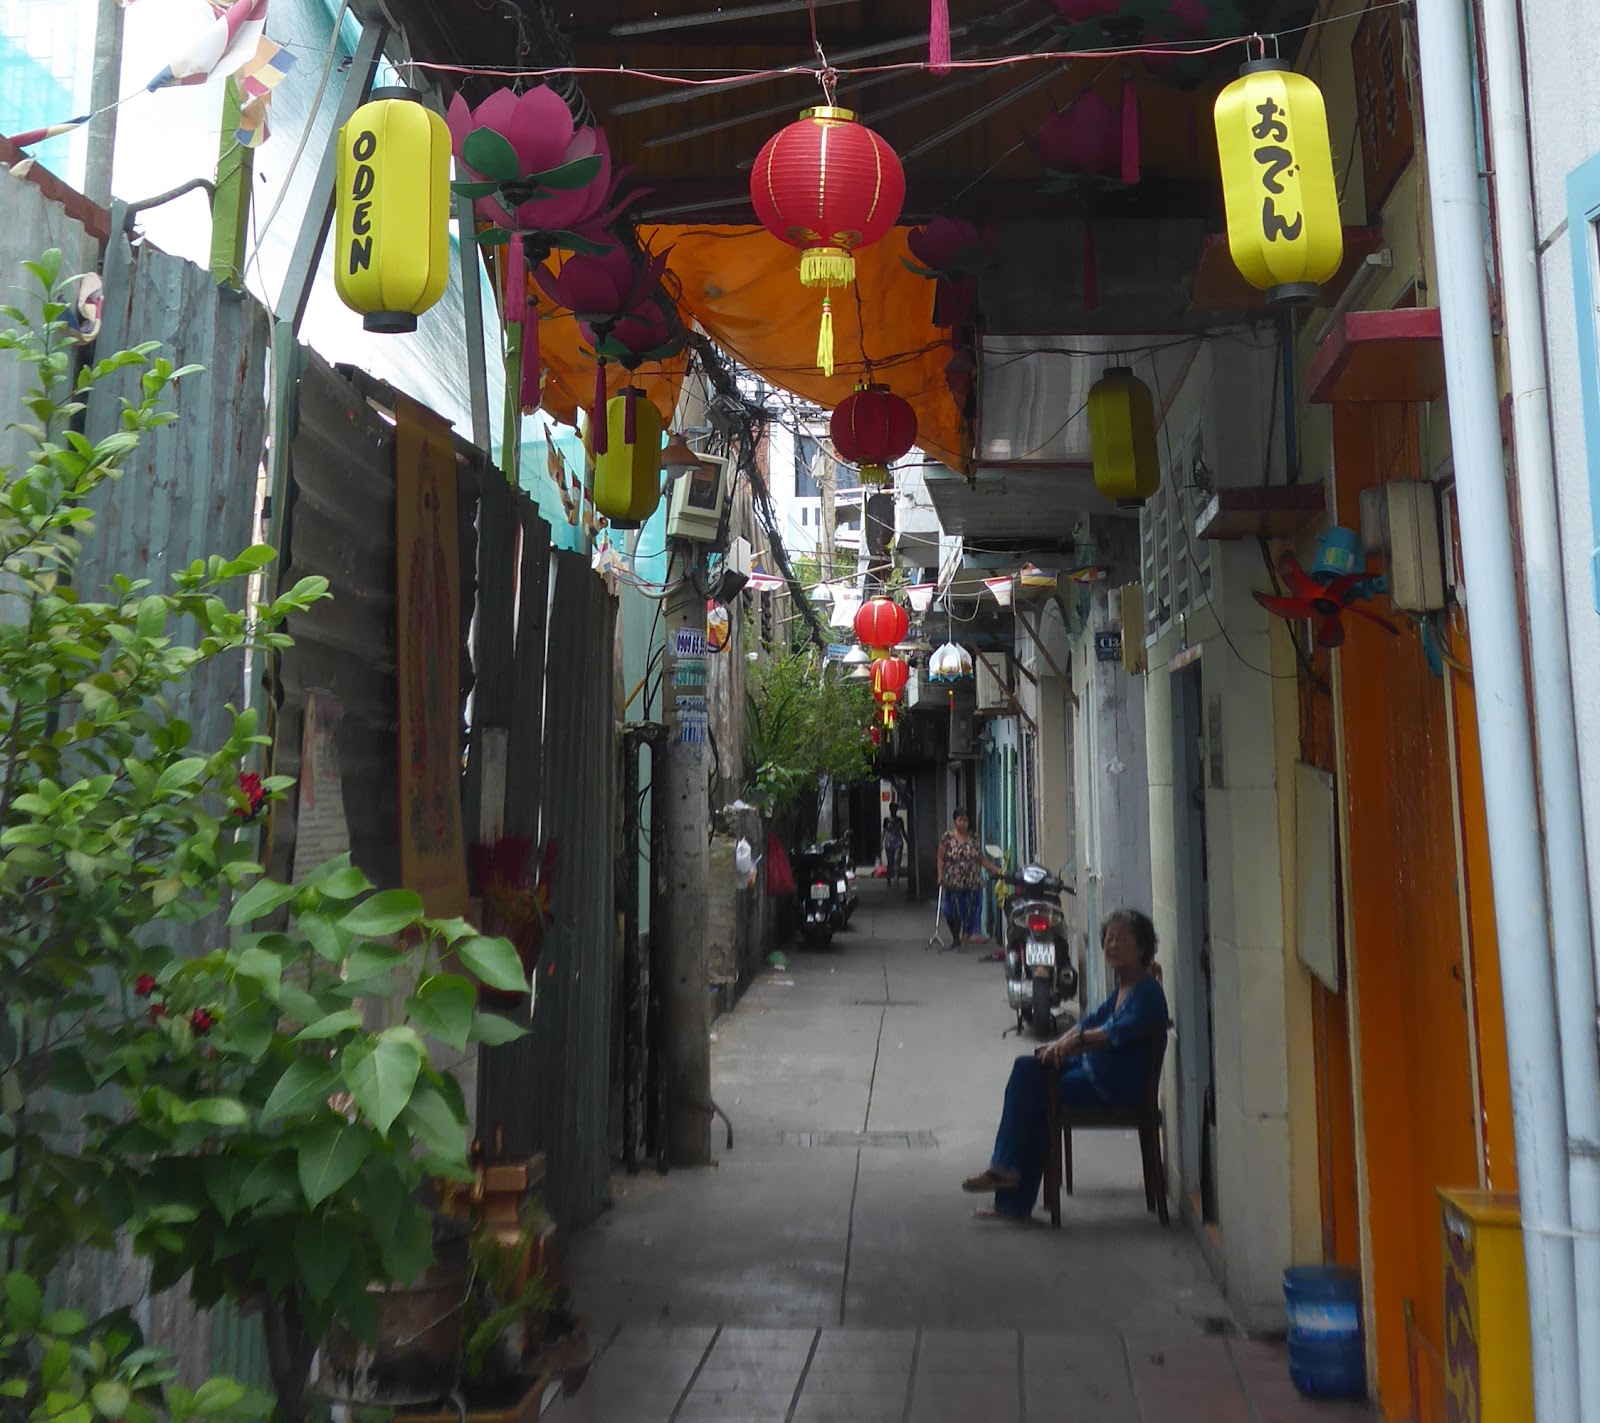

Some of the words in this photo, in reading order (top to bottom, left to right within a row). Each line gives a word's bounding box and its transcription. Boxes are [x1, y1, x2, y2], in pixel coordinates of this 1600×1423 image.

[349, 130, 377, 275] ODEN
[1251, 97, 1302, 243] おでん
